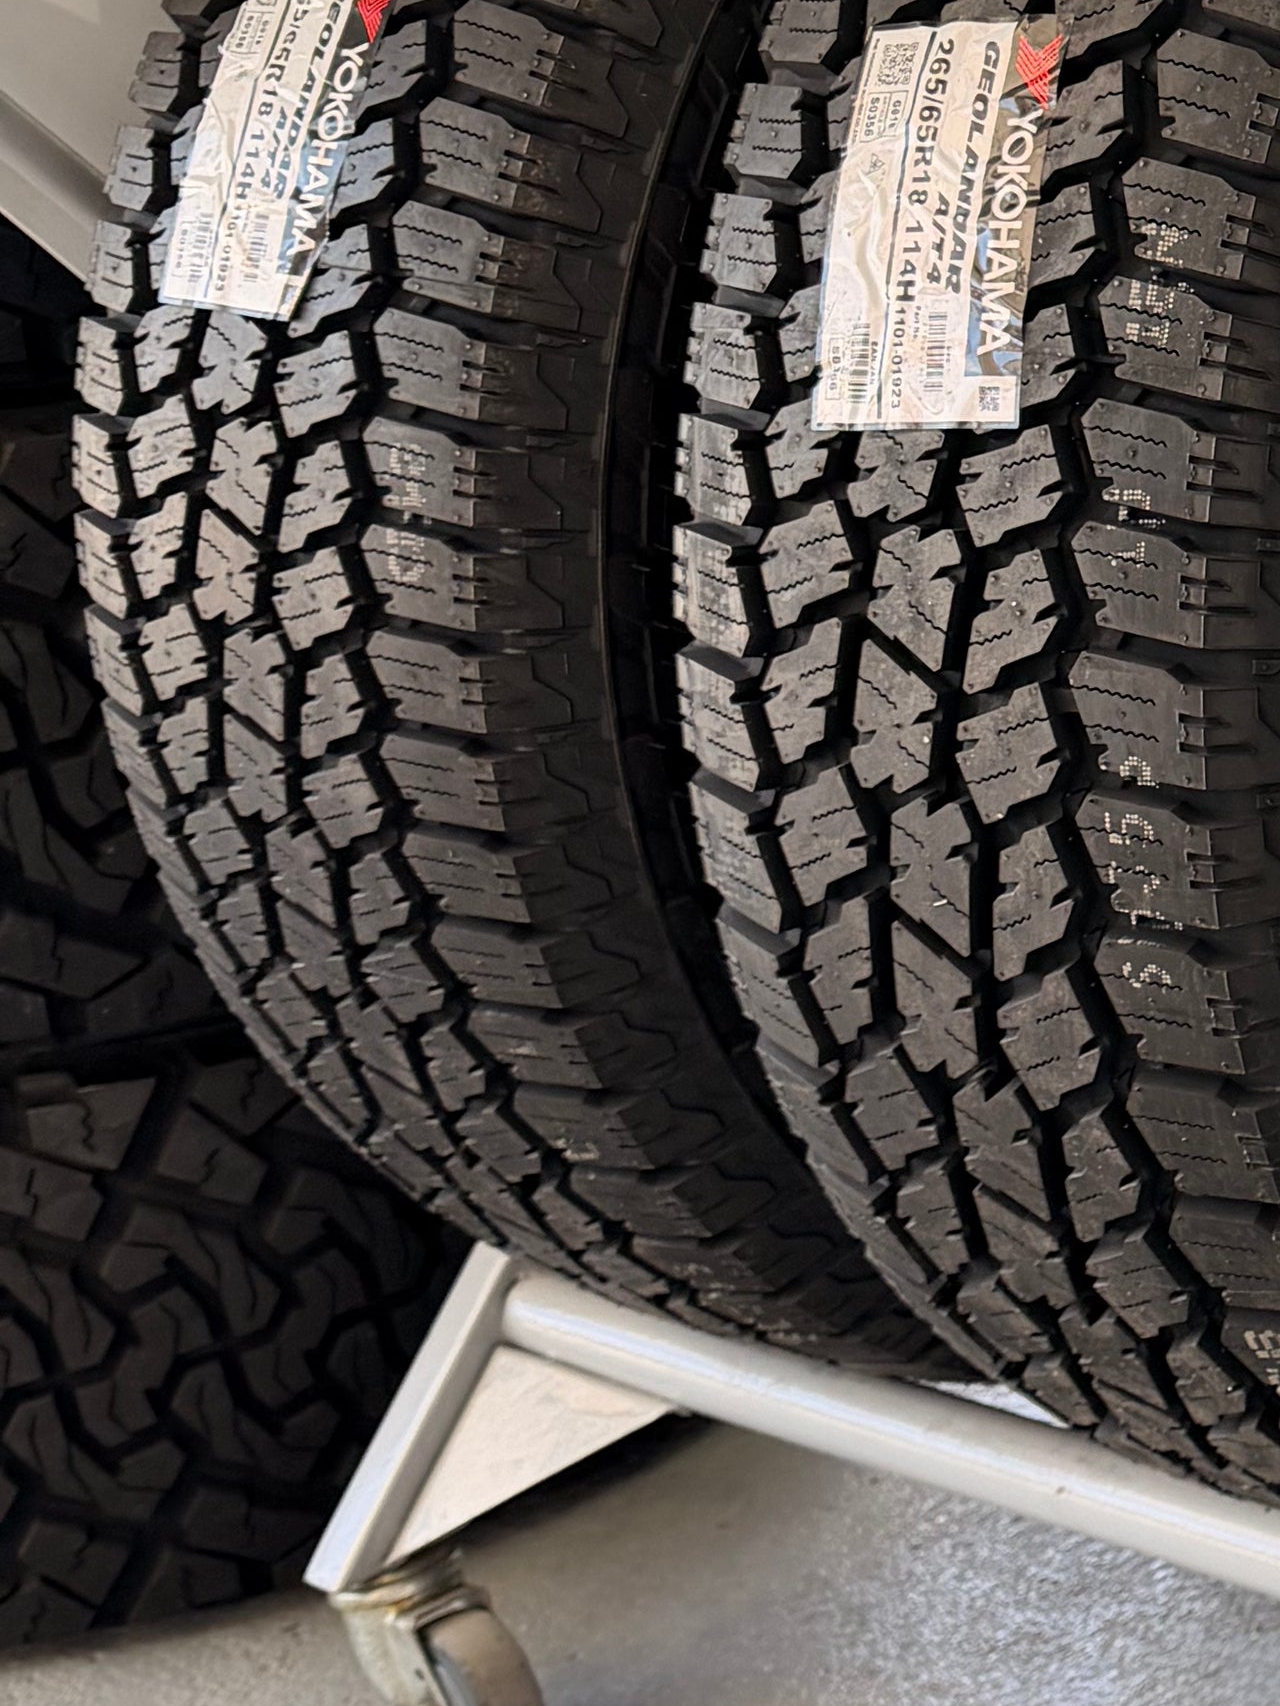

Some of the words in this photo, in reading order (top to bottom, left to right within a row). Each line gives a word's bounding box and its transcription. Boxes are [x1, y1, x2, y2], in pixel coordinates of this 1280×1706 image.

[234, 130, 266, 202] 114H
[288, 41, 371, 257] YOKOHAMA
[908, 39, 955, 206] 265/65R18
[945, 41, 1000, 295] GEOLANDAR
[896, 219, 925, 302] 114H
[926, 190, 951, 285] A/T4
[977, 108, 1044, 356] YOKOHAMA
[891, 307, 906, 409] 1101-01923
